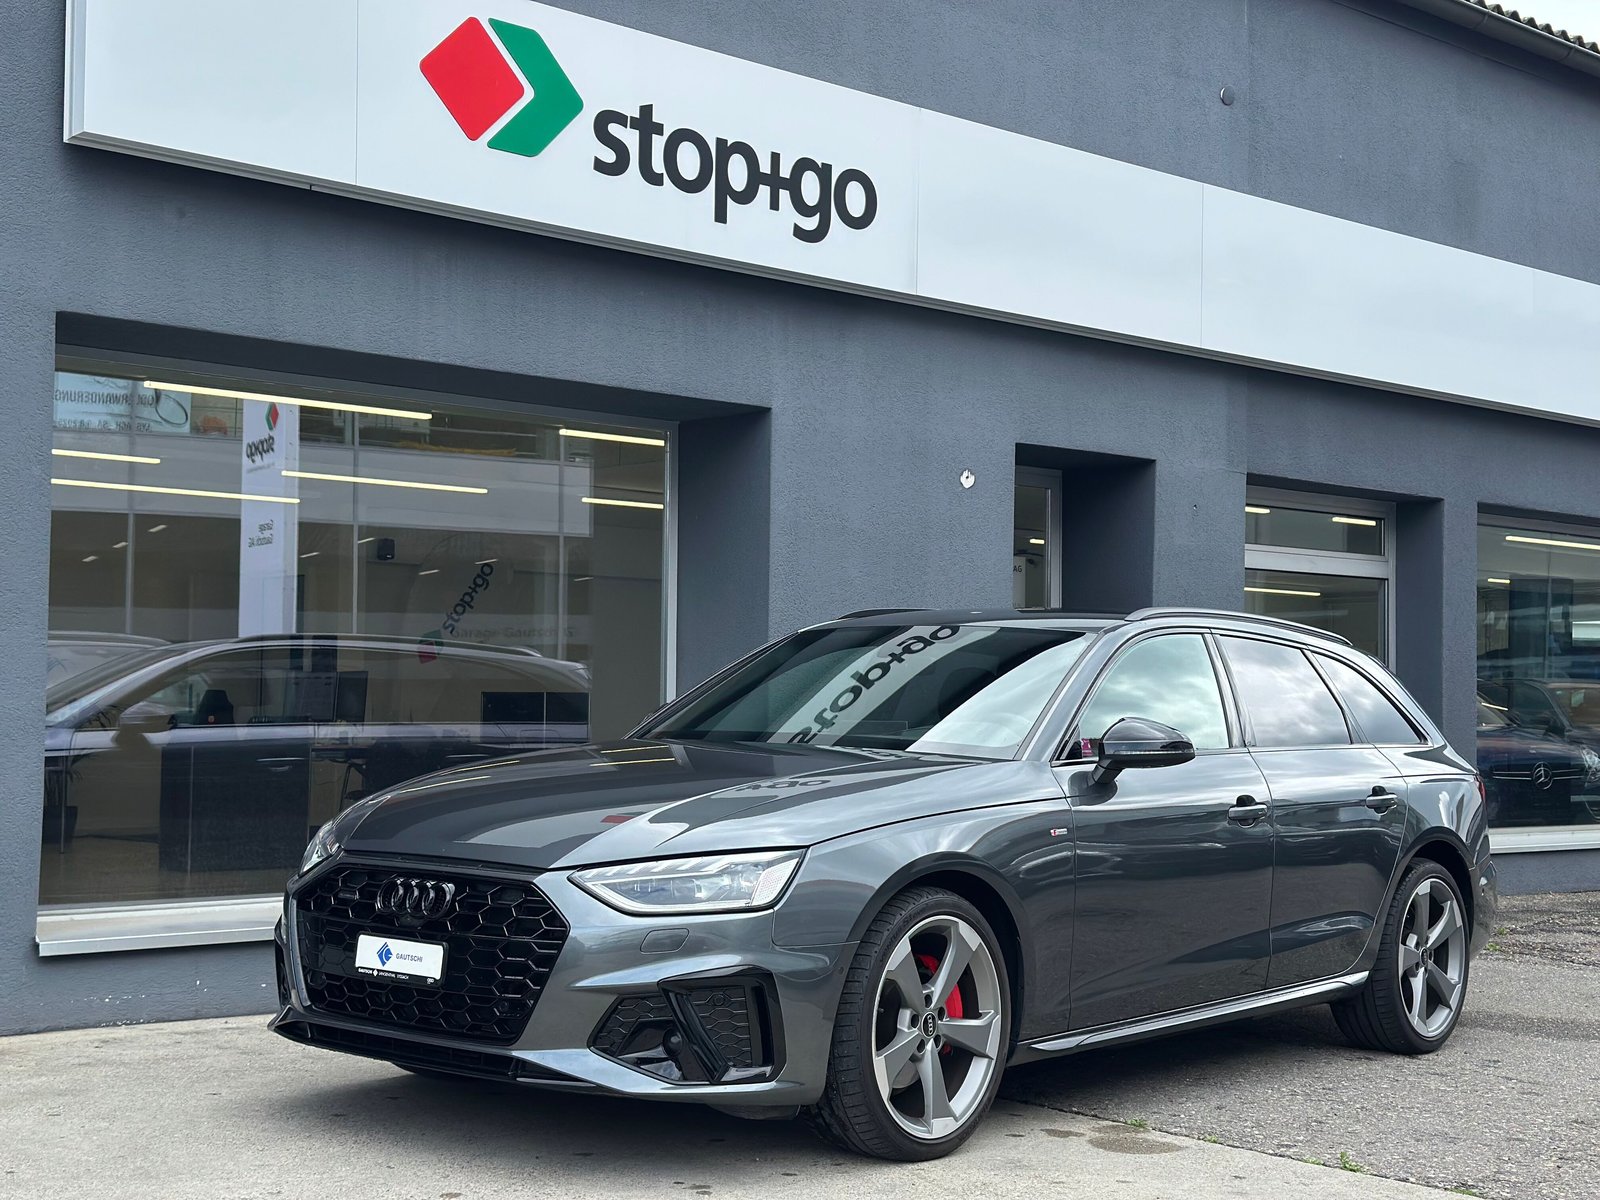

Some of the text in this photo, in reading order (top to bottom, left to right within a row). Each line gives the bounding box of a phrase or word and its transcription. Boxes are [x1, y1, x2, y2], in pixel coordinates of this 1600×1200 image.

[593, 104, 877, 243] stop+go
[442, 562, 495, 635] stop+go
[395, 952, 423, 963] GAUTSCHI
